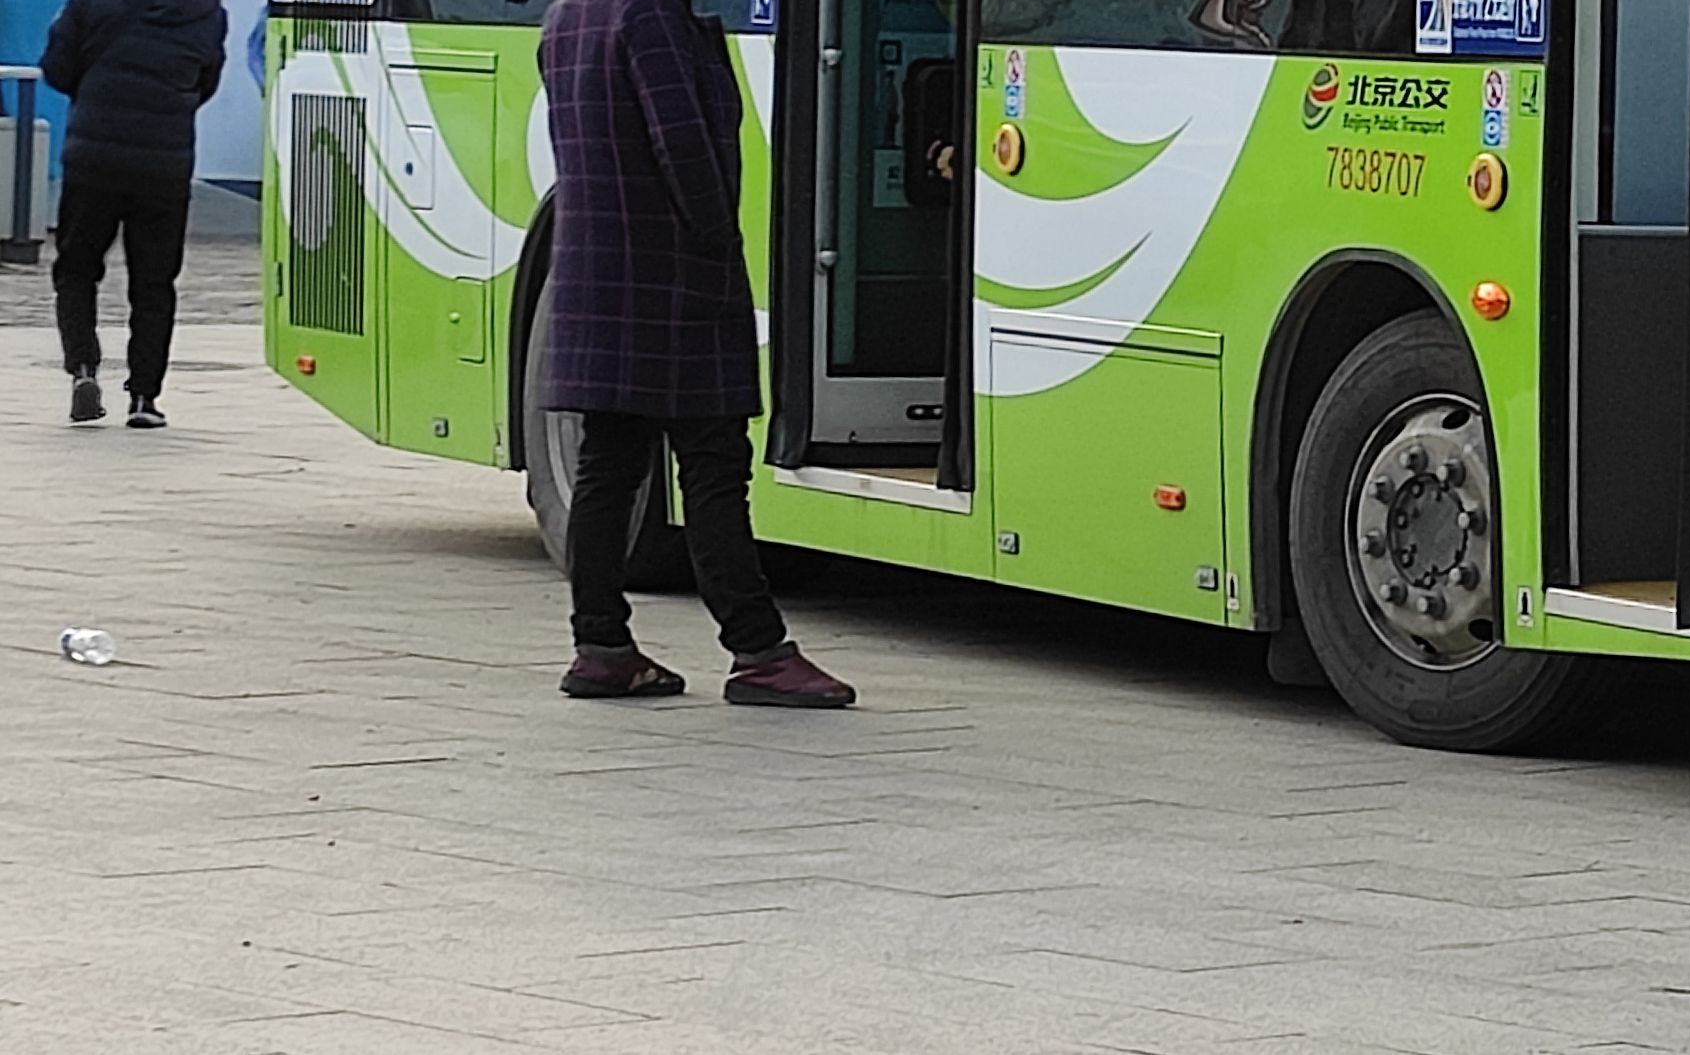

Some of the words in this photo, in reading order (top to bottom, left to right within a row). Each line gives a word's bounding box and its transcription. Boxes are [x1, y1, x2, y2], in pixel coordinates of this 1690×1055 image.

[1345, 74, 1451, 110] 北京公交
[1326, 146, 1426, 198] 7838707
